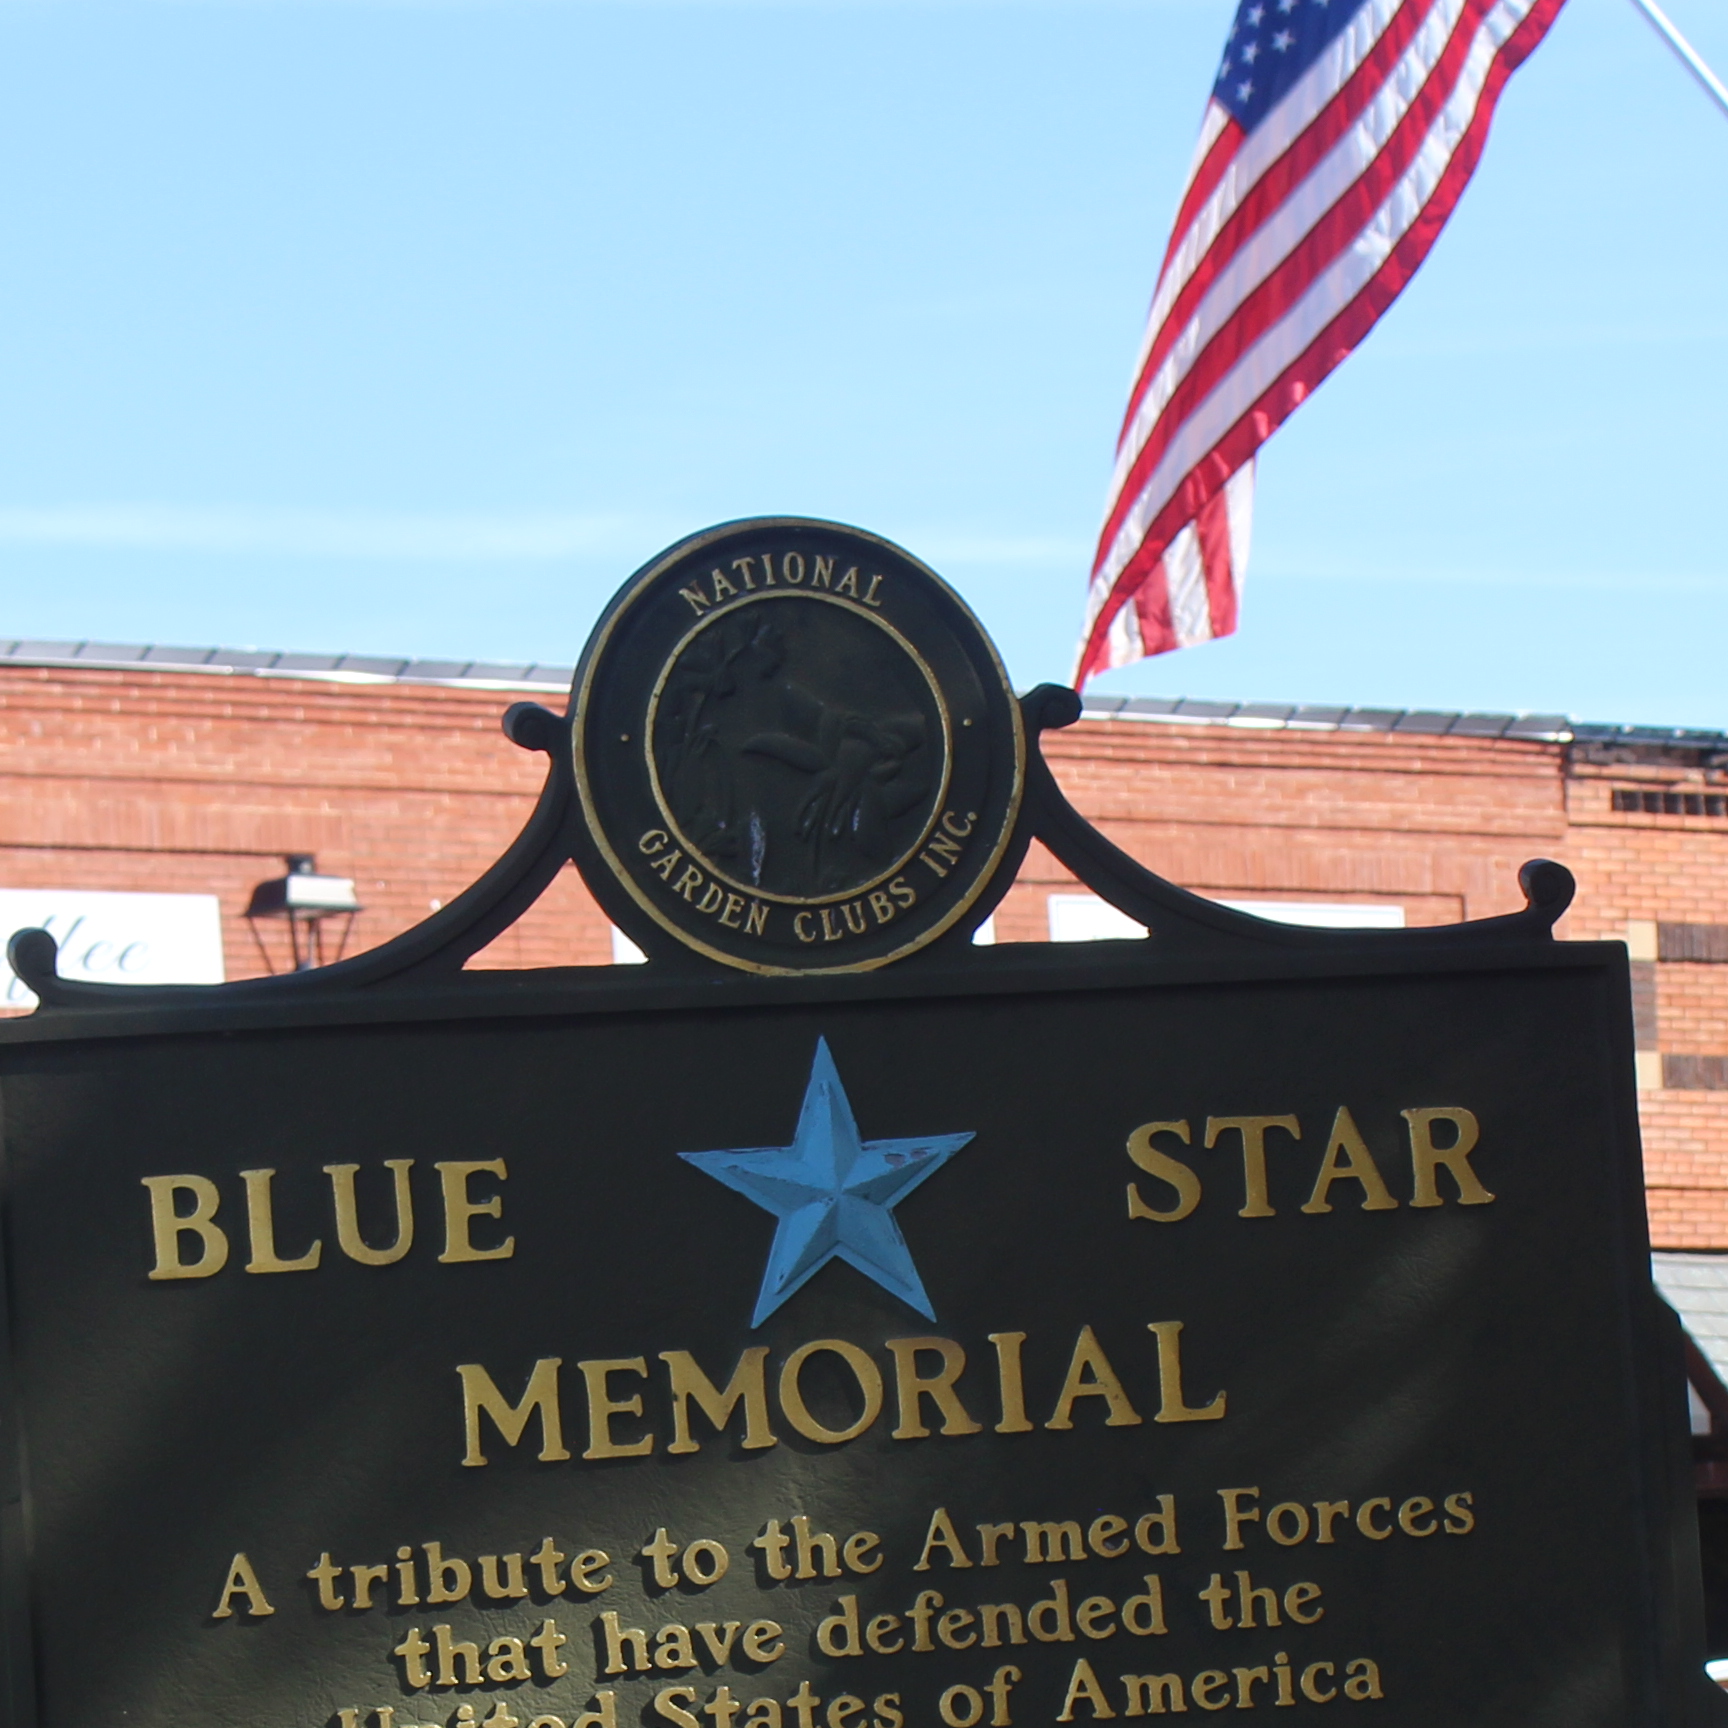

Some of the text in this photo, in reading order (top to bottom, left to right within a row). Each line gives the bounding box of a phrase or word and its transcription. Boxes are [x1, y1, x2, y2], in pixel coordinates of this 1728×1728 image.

[679, 551, 883, 616] NATIONAL
[638, 809, 978, 943] GARDEN CLUBS INC.
[141, 1105, 1495, 1280] BLUE STAR
[456, 1321, 1227, 1466] MEMORIAL
[212, 1486, 1475, 1618] A tribute to the Armed Forces
[394, 1570, 1323, 1690] that have defended the
[938, 1664, 1021, 1728] of
[1056, 1651, 1384, 1722] America
